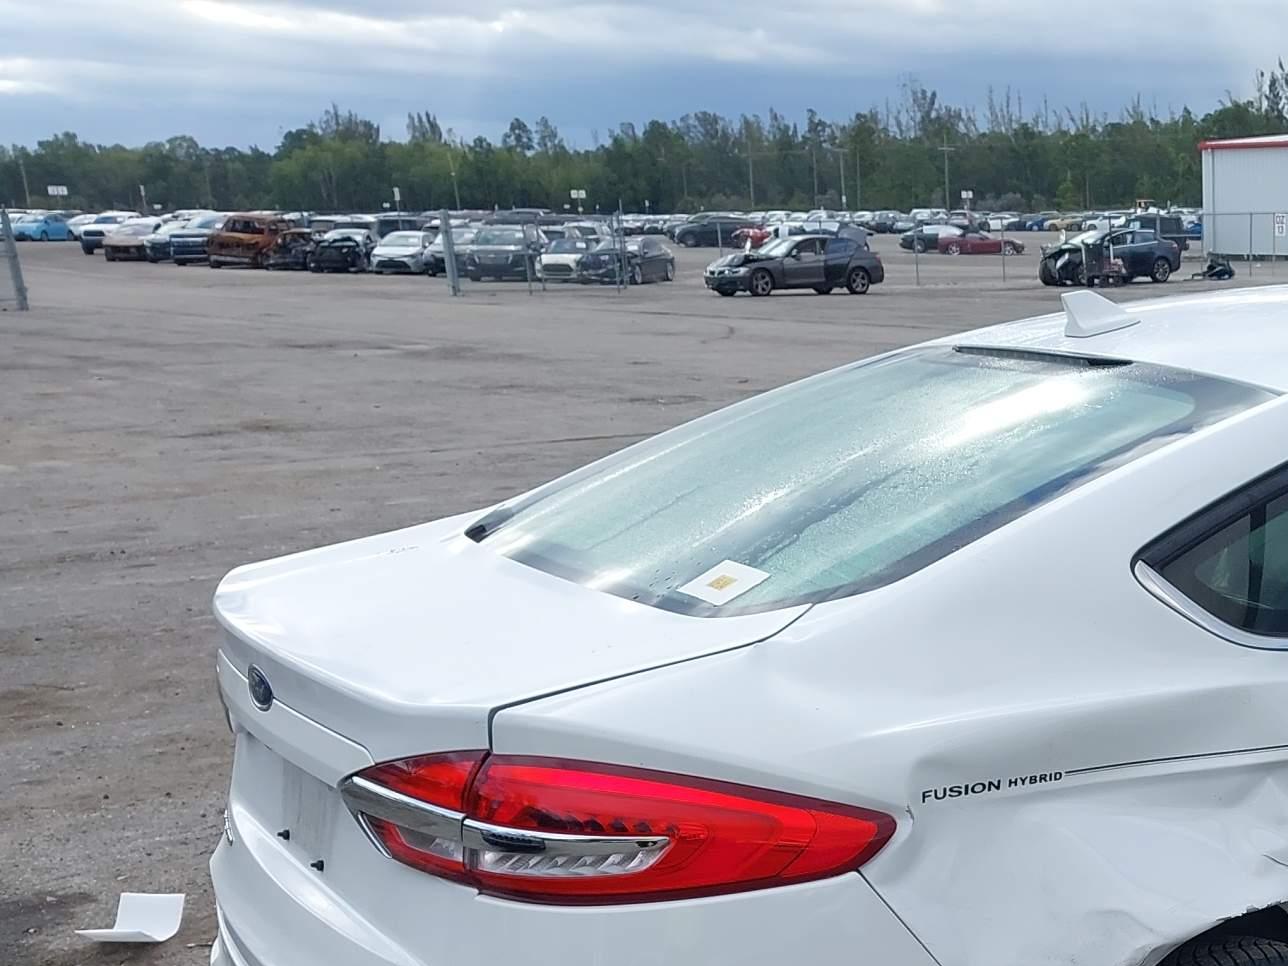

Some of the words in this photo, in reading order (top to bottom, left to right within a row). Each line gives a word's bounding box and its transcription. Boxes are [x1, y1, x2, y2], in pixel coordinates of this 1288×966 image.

[1275, 215, 1286, 225] DZ
[921, 779, 1001, 804] FUSION
[1008, 771, 1063, 788] HYBRID
